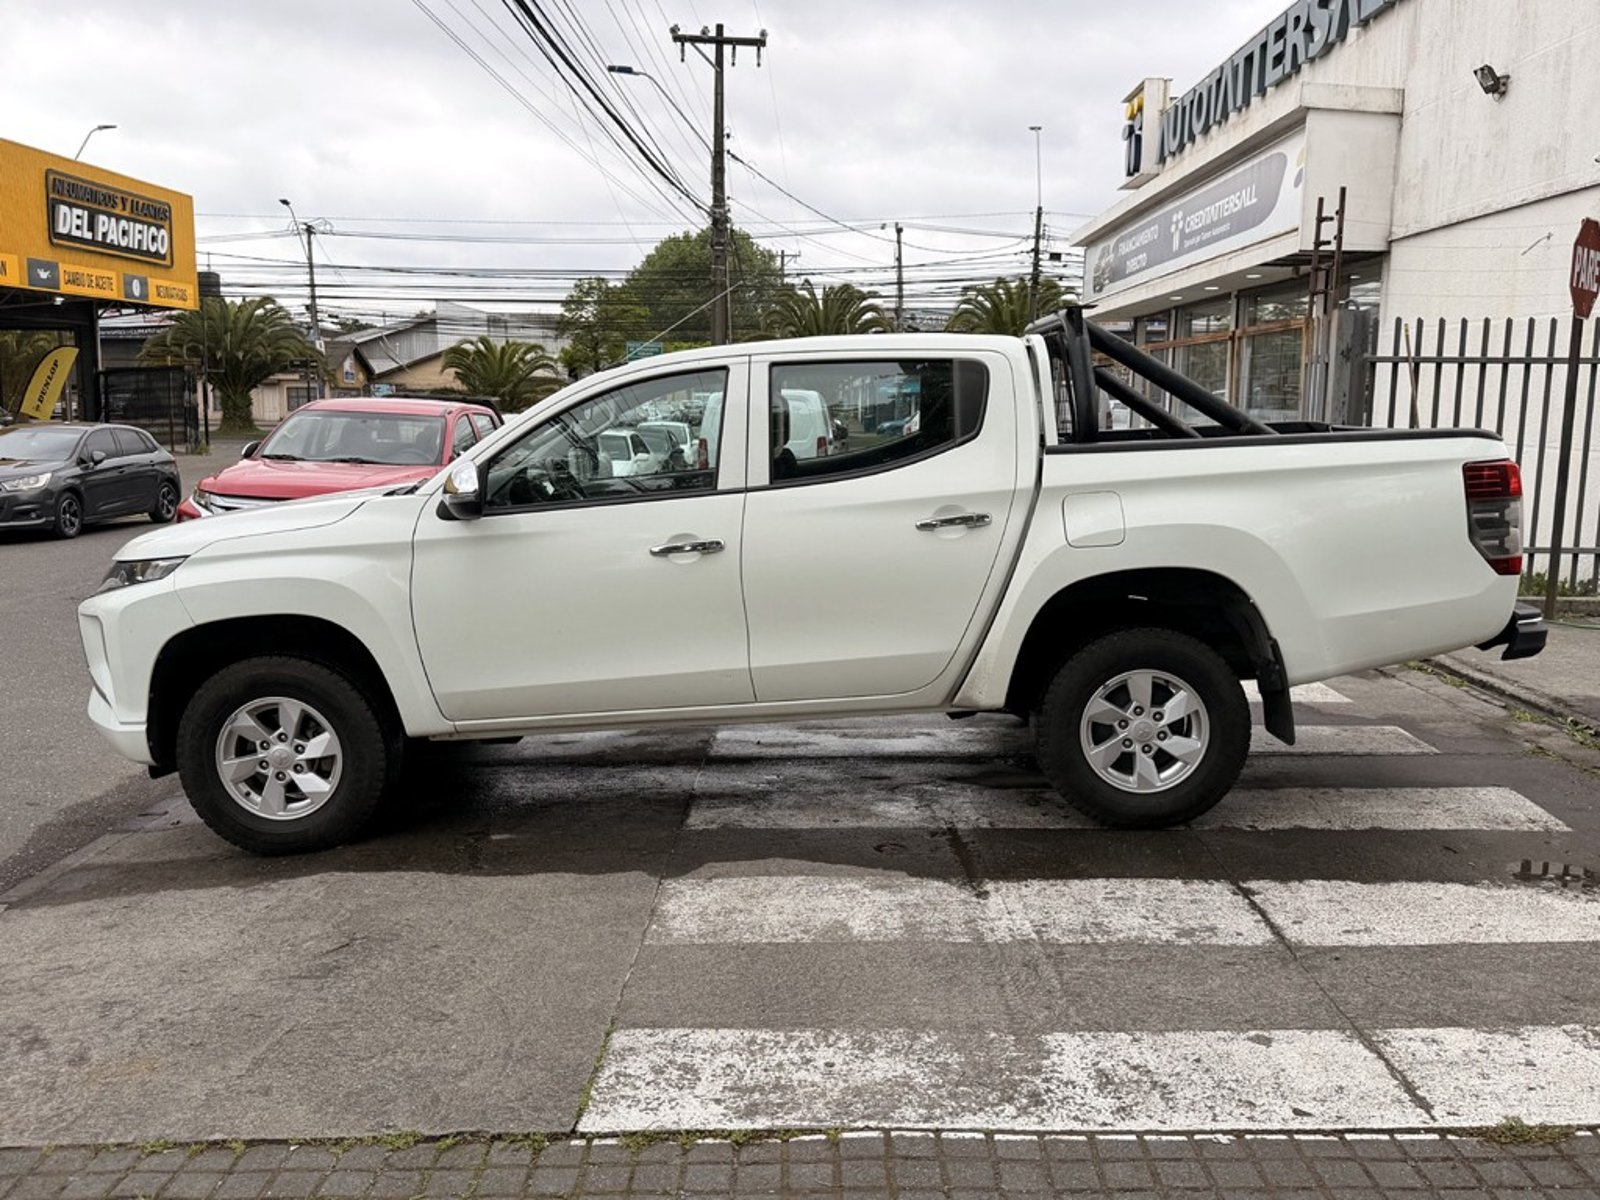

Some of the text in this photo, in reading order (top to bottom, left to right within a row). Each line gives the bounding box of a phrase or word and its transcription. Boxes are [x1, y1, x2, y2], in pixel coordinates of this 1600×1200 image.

[1157, 0, 1396, 164] AUTOTATTERSA
[53, 177, 169, 220] NEUMATICOS Y LLANTAS
[55, 204, 169, 255] DEL PACIFICO
[63, 269, 114, 291] CAMBIO DE ACEITE
[1572, 245, 1600, 293] PARE
[38, 359, 59, 404] DUNLOP
